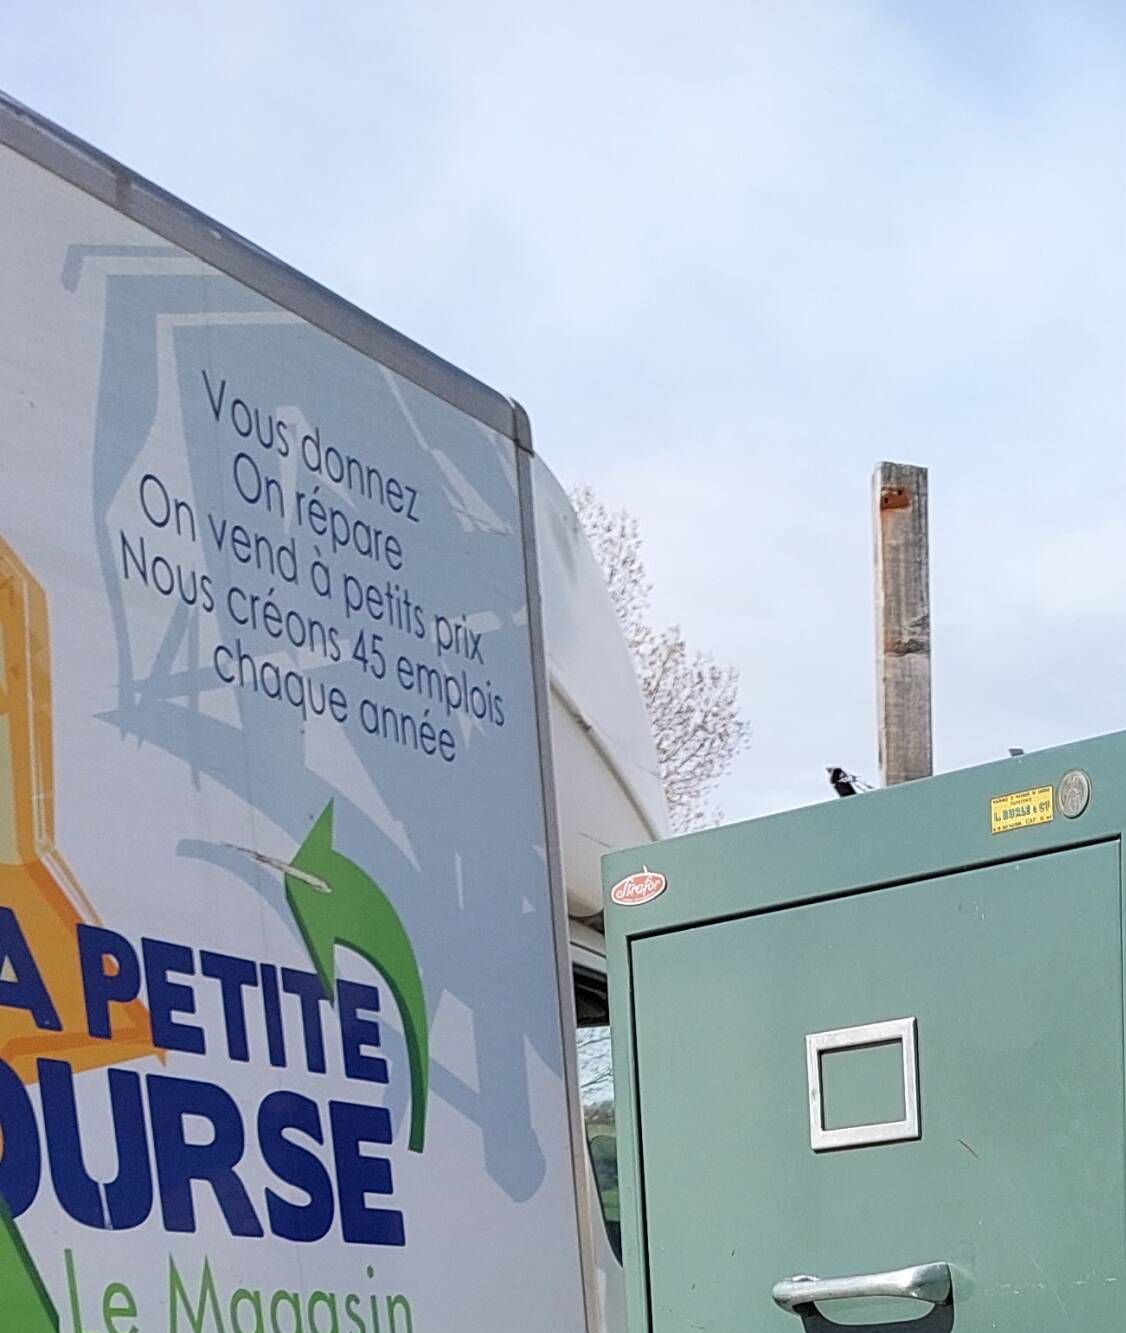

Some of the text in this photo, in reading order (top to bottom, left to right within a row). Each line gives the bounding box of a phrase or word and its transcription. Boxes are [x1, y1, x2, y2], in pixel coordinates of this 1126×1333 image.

[202, 369, 420, 523] Vous donnez
[233, 452, 403, 569] On répare
[121, 530, 505, 726] Nous créons 45 emplois
[139, 474, 484, 665] On vend à petits prix
[214, 640, 456, 762] chaque année
[76, 923, 389, 1085] PETITE
